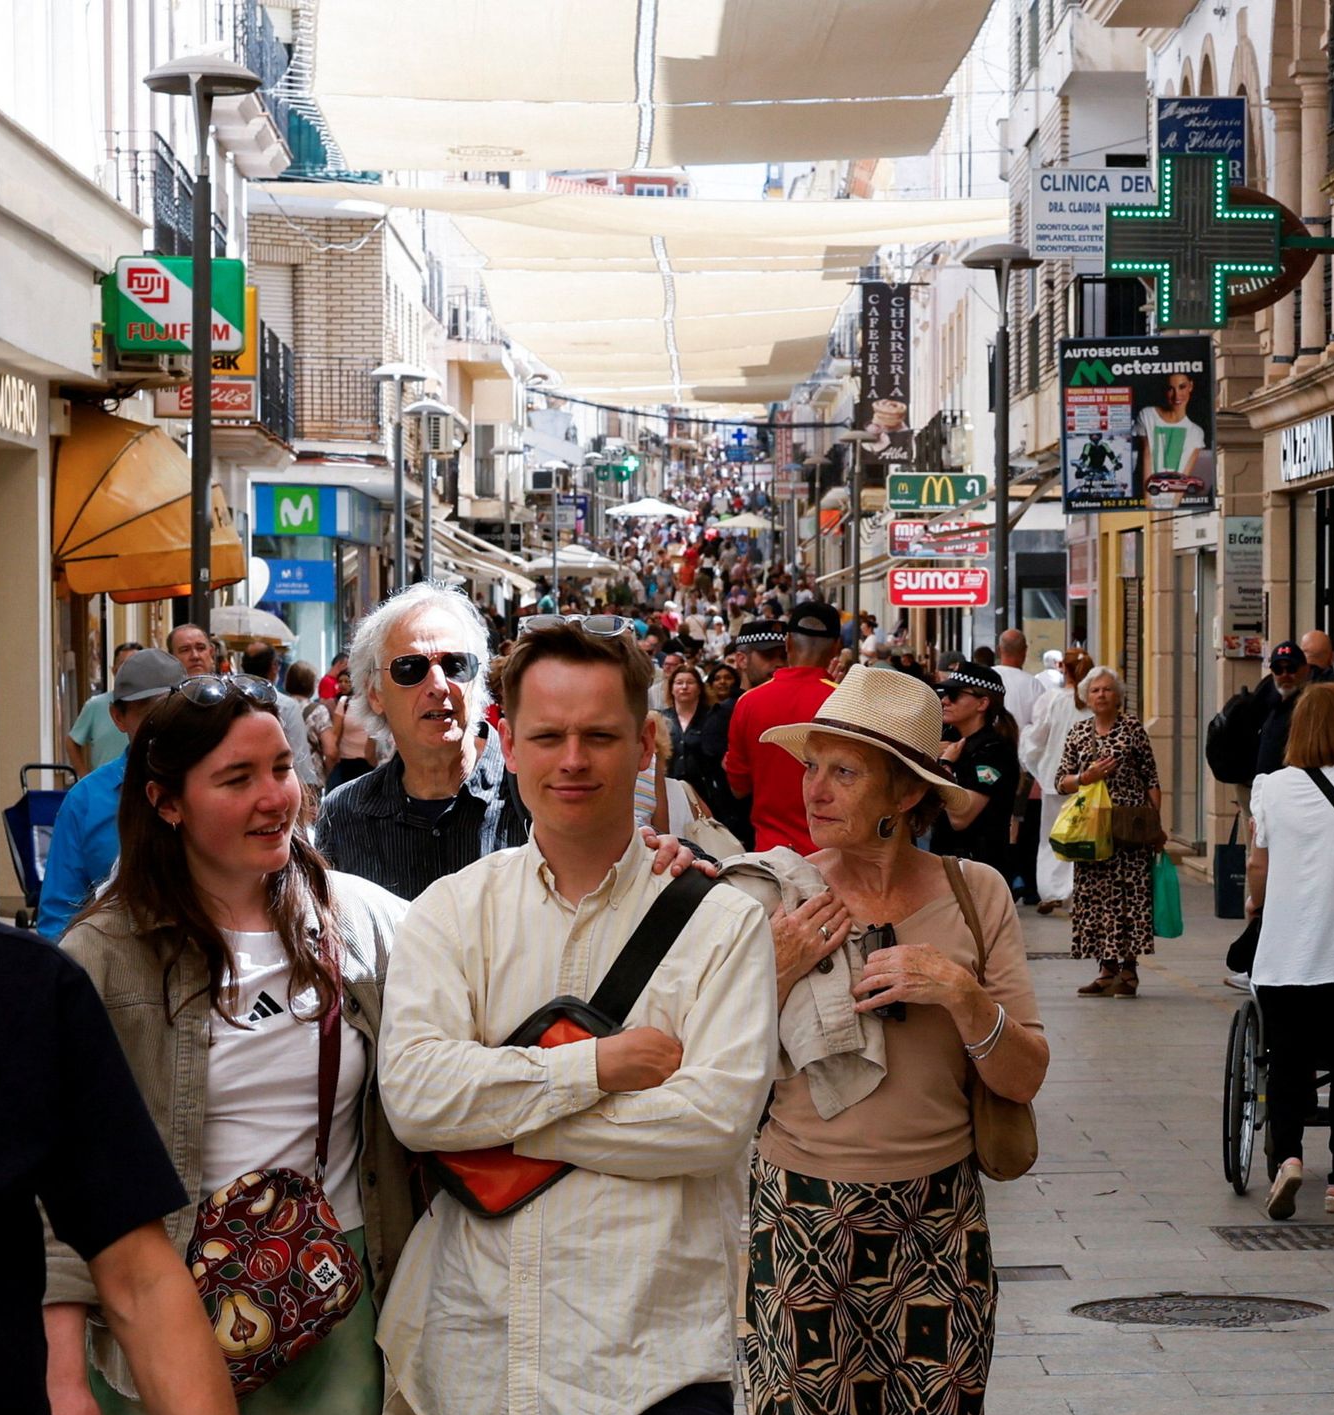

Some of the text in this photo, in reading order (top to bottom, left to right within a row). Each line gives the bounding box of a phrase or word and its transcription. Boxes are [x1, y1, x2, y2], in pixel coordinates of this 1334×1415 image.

[1040, 174, 1110, 193] CLINICA
[1048, 201, 1065, 213] DRA.
[1069, 201, 1101, 213] CLAUDIA
[127, 267, 170, 304] FUJI
[126, 322, 231, 342] FUJIFM
[1064, 346, 1160, 359] AUTOESCUELAS
[1228, 533, 1238, 545] El
[893, 571, 960, 590] suma
